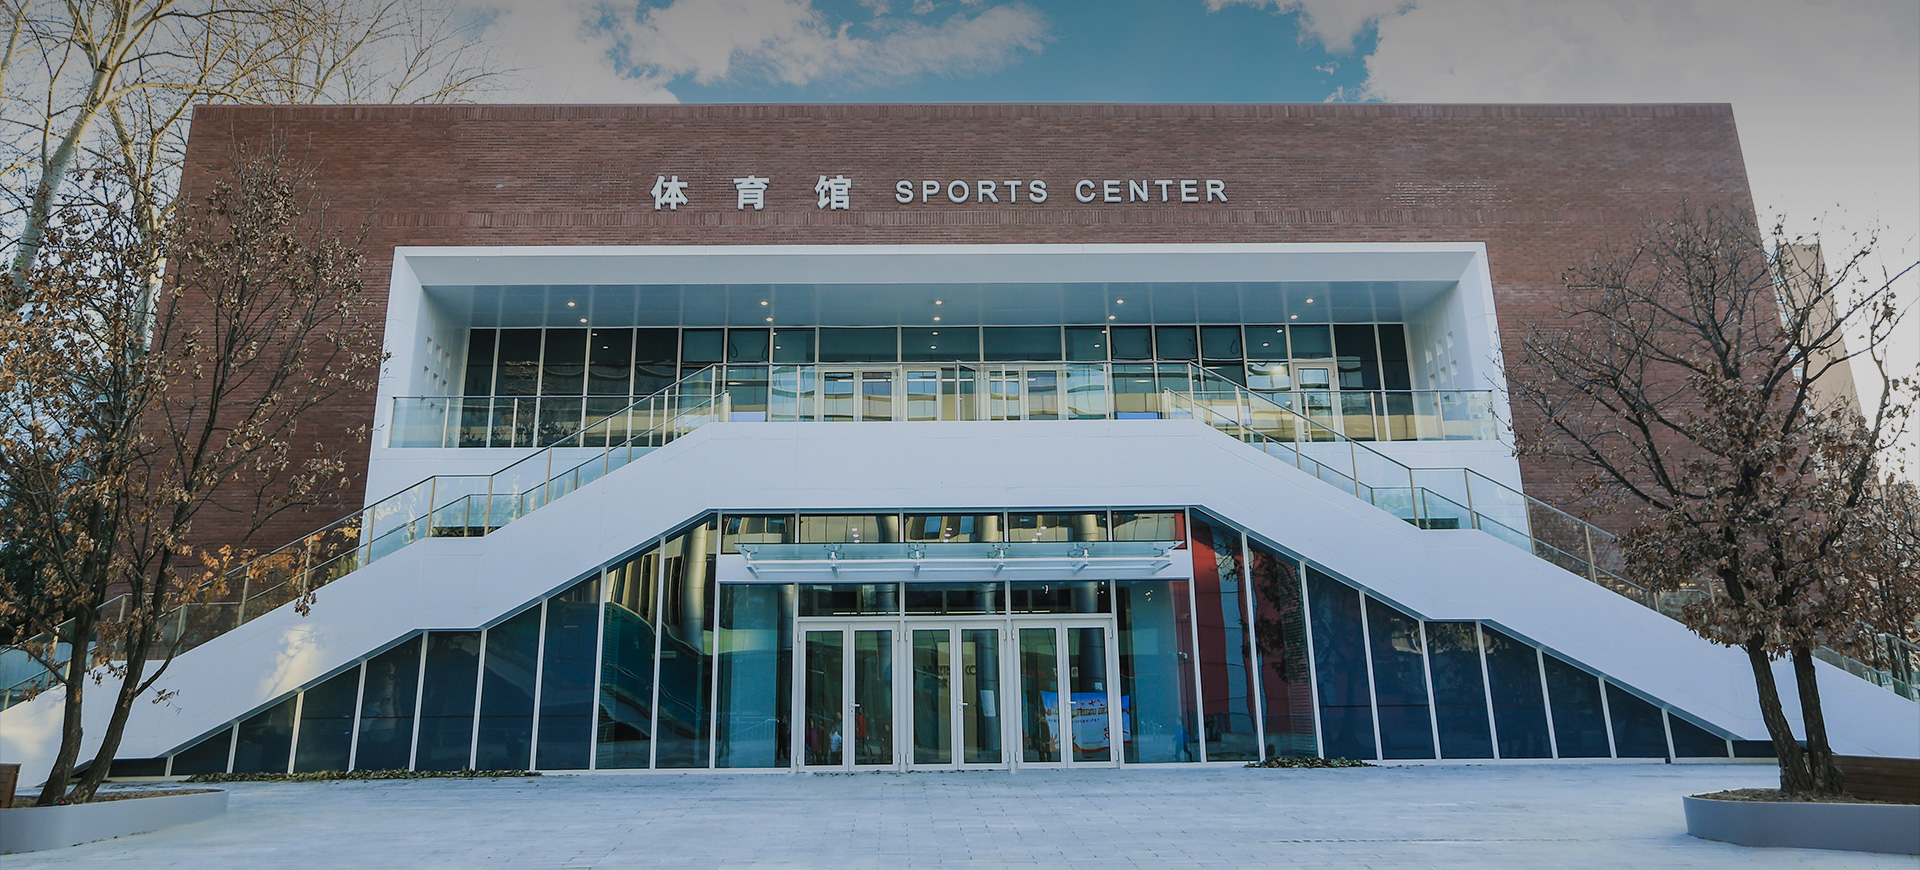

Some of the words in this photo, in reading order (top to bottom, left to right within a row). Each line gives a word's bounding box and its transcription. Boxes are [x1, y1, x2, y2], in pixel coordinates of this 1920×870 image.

[650, 174, 853, 211] 体育馆
[894, 179, 1049, 204] SPORTS
[1074, 178, 1229, 204] CENTER
